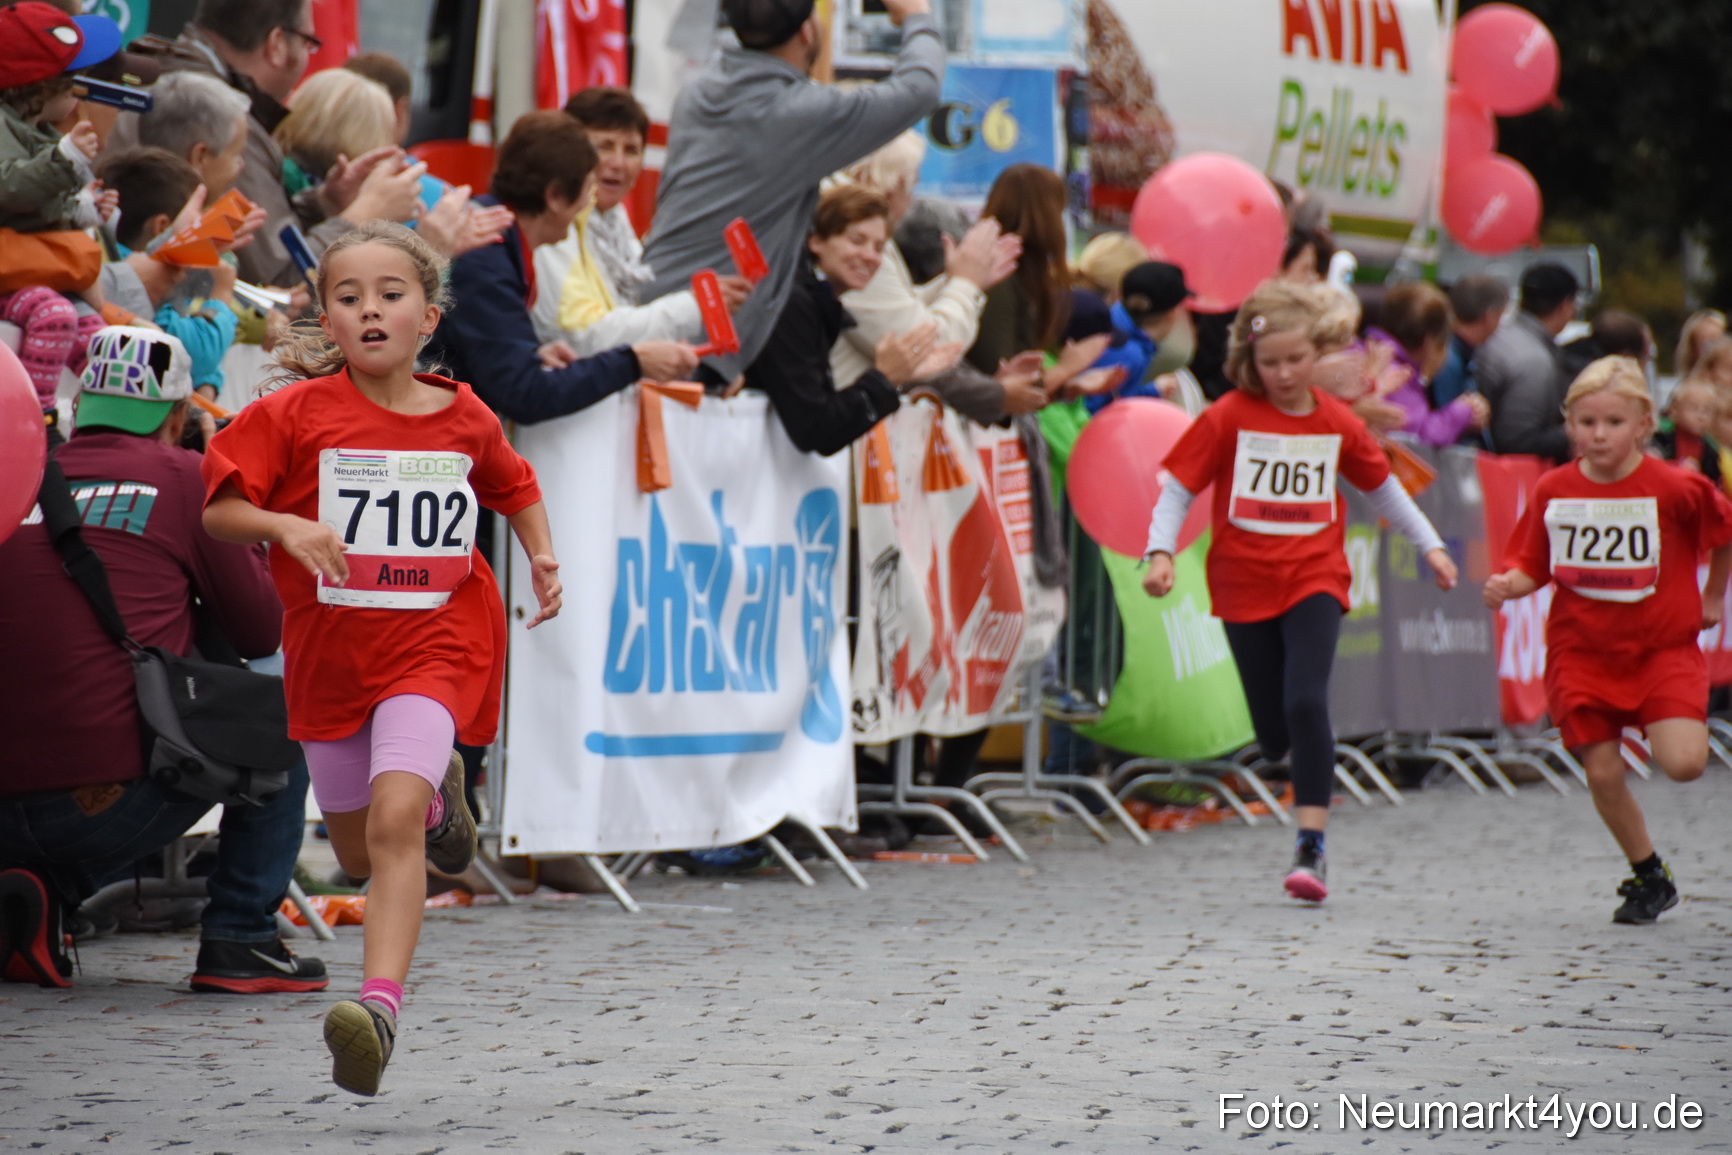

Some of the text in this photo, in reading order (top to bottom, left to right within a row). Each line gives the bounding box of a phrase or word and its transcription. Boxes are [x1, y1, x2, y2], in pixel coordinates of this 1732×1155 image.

[1281, 0, 1411, 75] AVIA
[1265, 77, 1408, 198] Pellets
[334, 466, 389, 478] NeuerMarkt
[1248, 458, 1327, 497] 7061
[338, 488, 468, 548] 7102
[1558, 524, 1650, 563] 7220
[376, 563, 430, 587] Anna
